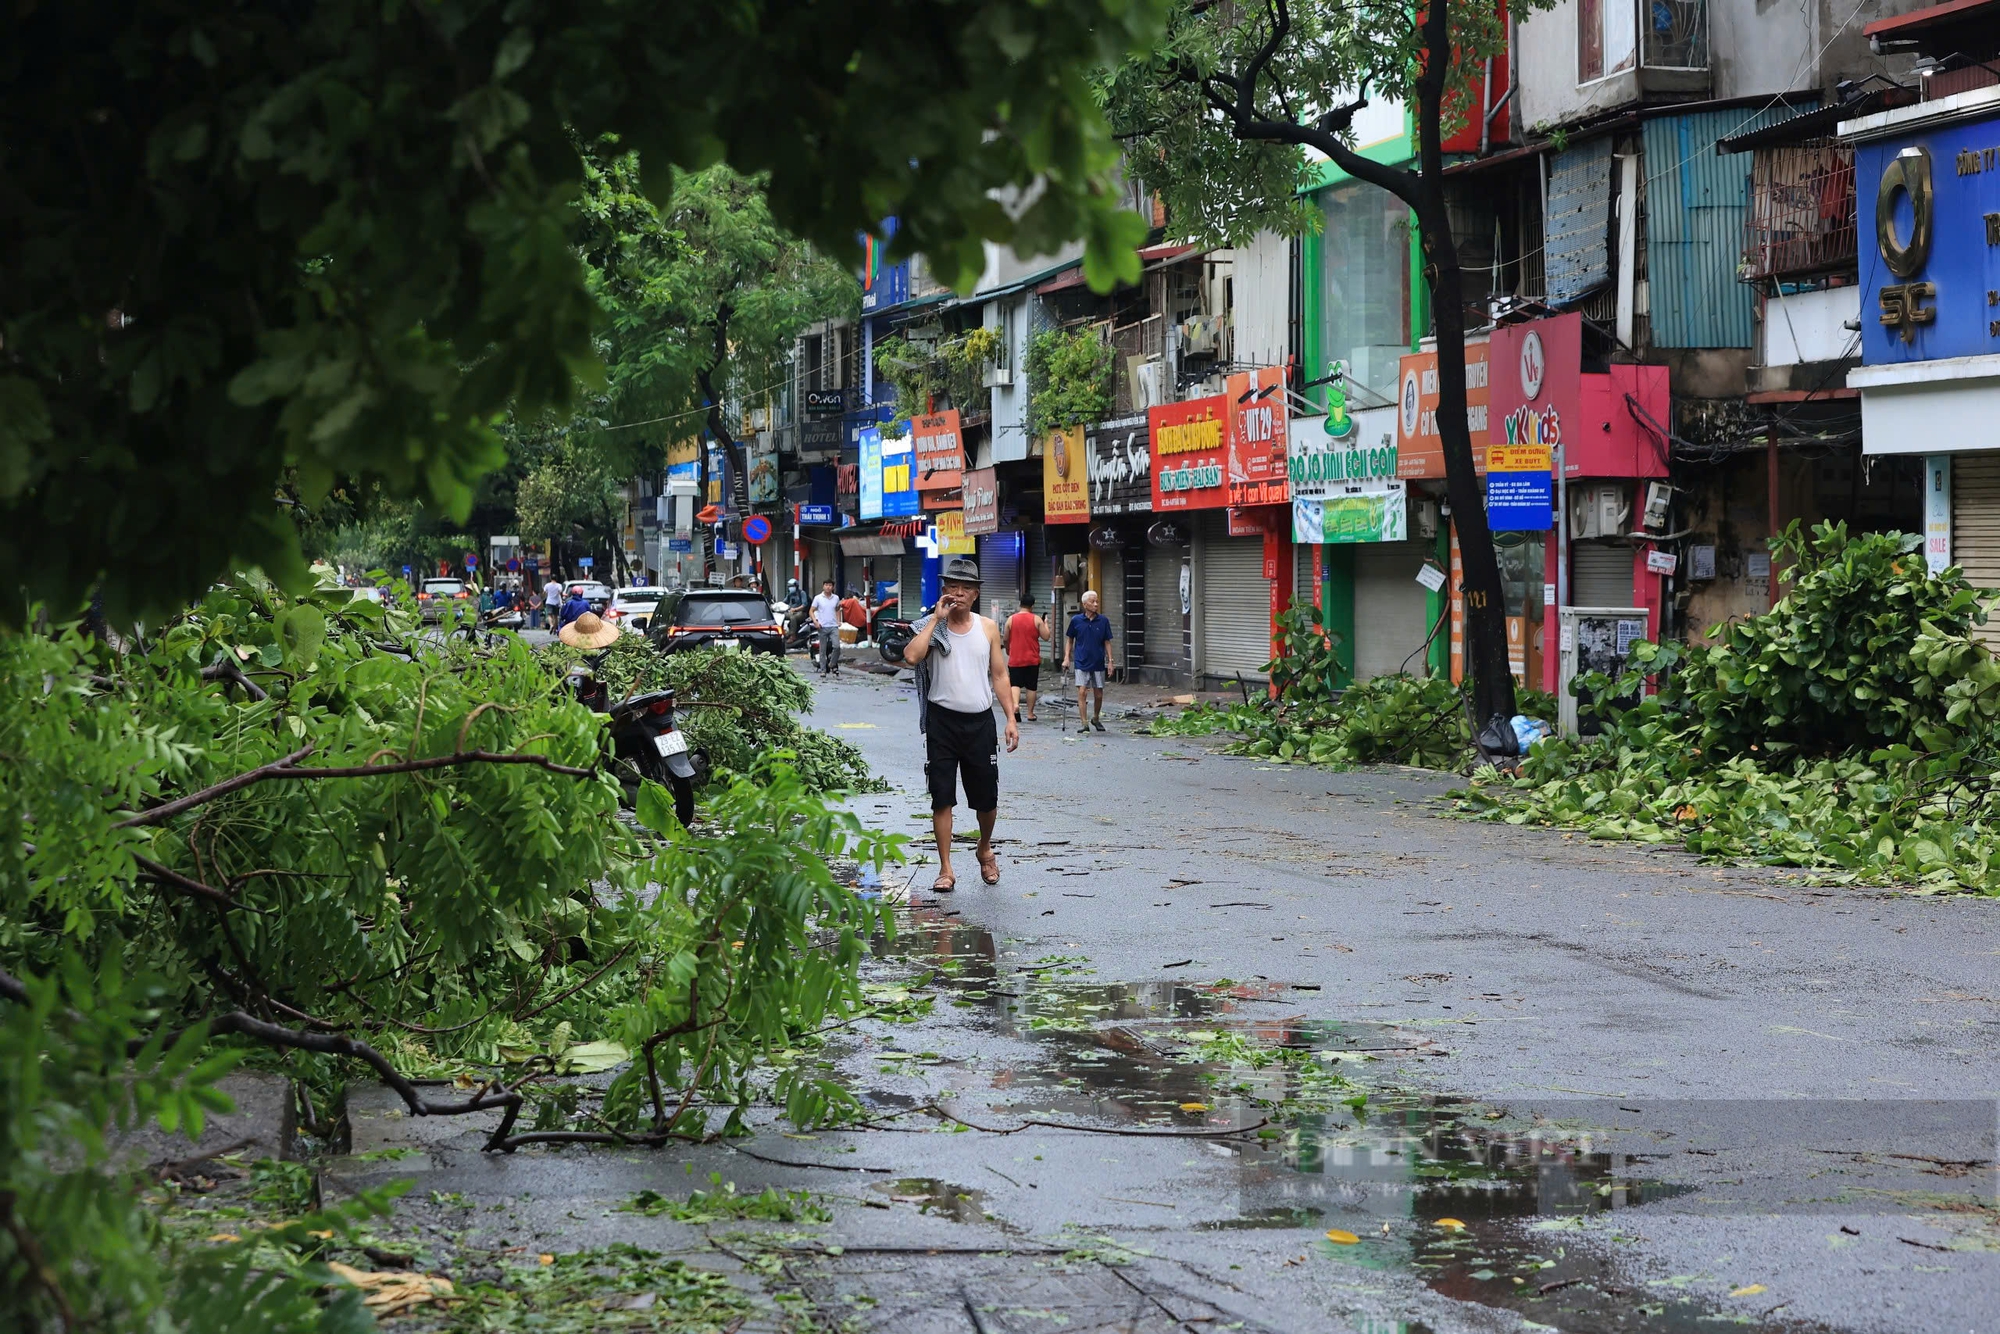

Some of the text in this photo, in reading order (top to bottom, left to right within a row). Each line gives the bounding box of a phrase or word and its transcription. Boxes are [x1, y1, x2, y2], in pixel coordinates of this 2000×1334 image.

[1956, 148, 1995, 176] CÔNG TY
[1260, 405, 1272, 441] 29
[804, 432, 838, 443] HOTEL
[1930, 538, 1946, 553] SALE
